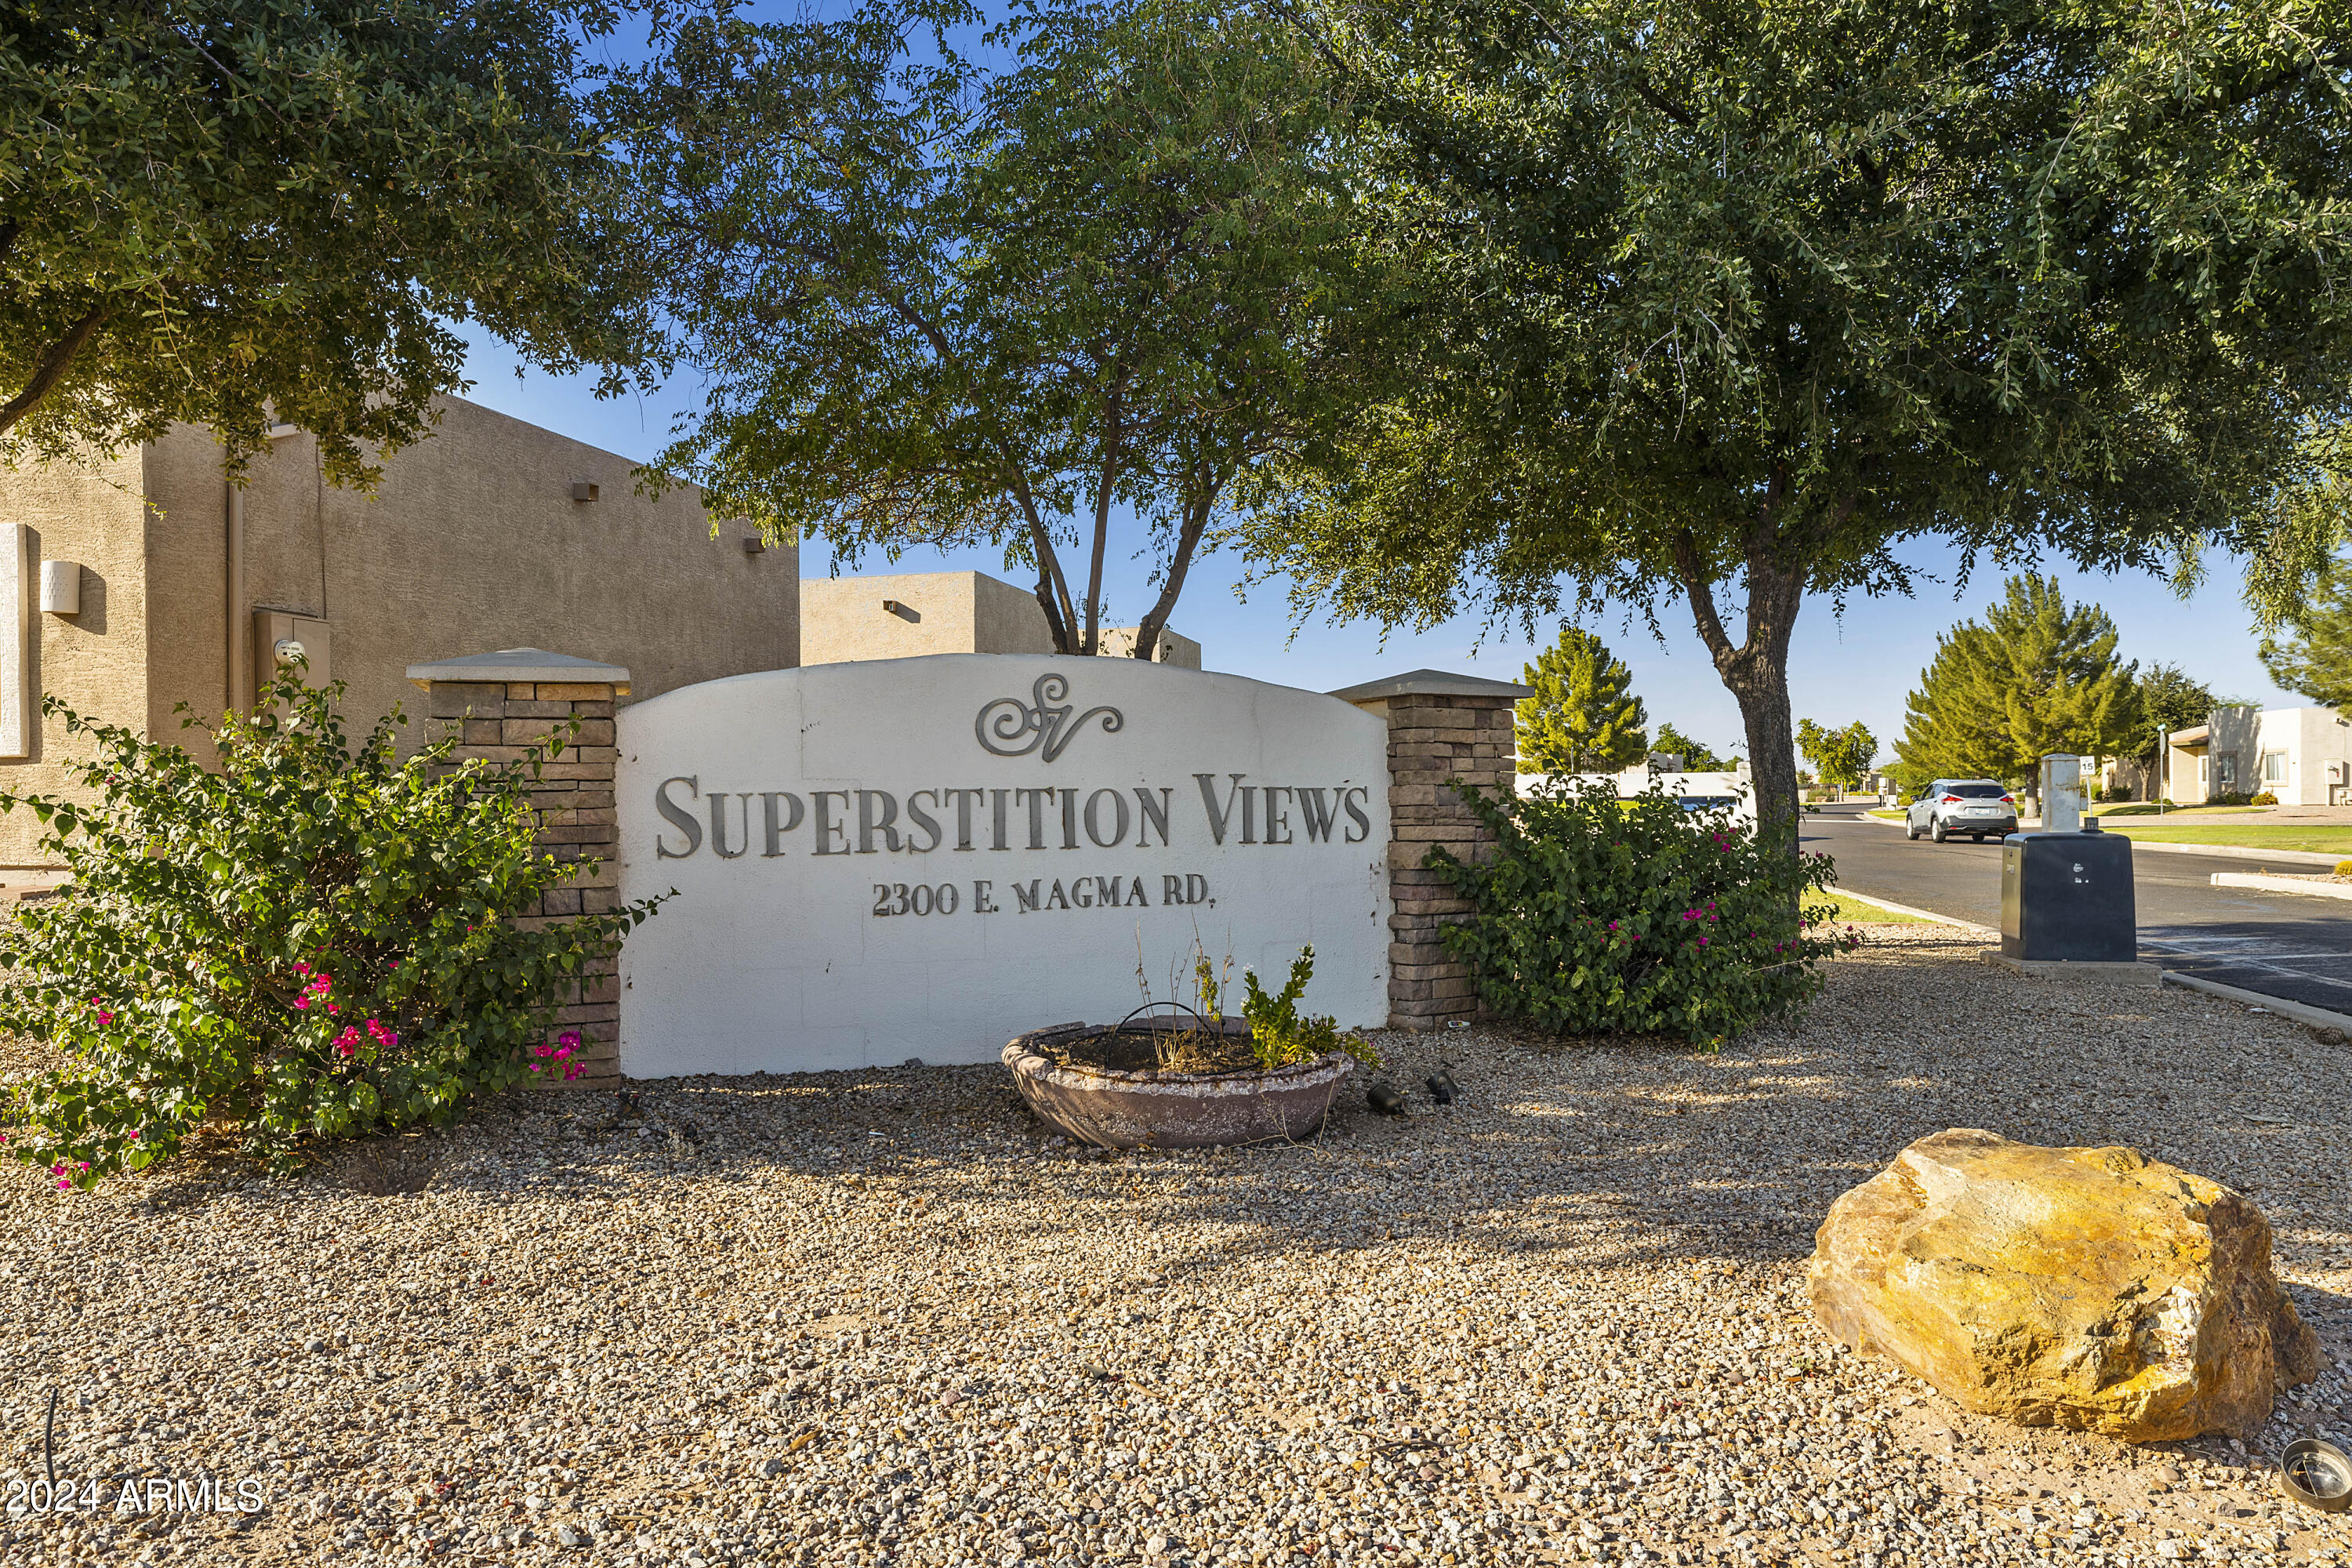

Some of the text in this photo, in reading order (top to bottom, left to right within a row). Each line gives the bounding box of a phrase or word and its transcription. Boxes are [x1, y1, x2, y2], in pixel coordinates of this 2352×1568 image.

[655, 773, 1370, 859] SUPERSTITION VIEWS
[873, 883, 959, 916] 2300
[973, 880, 1000, 913] E.
[1011, 875, 1149, 914] MAGMA
